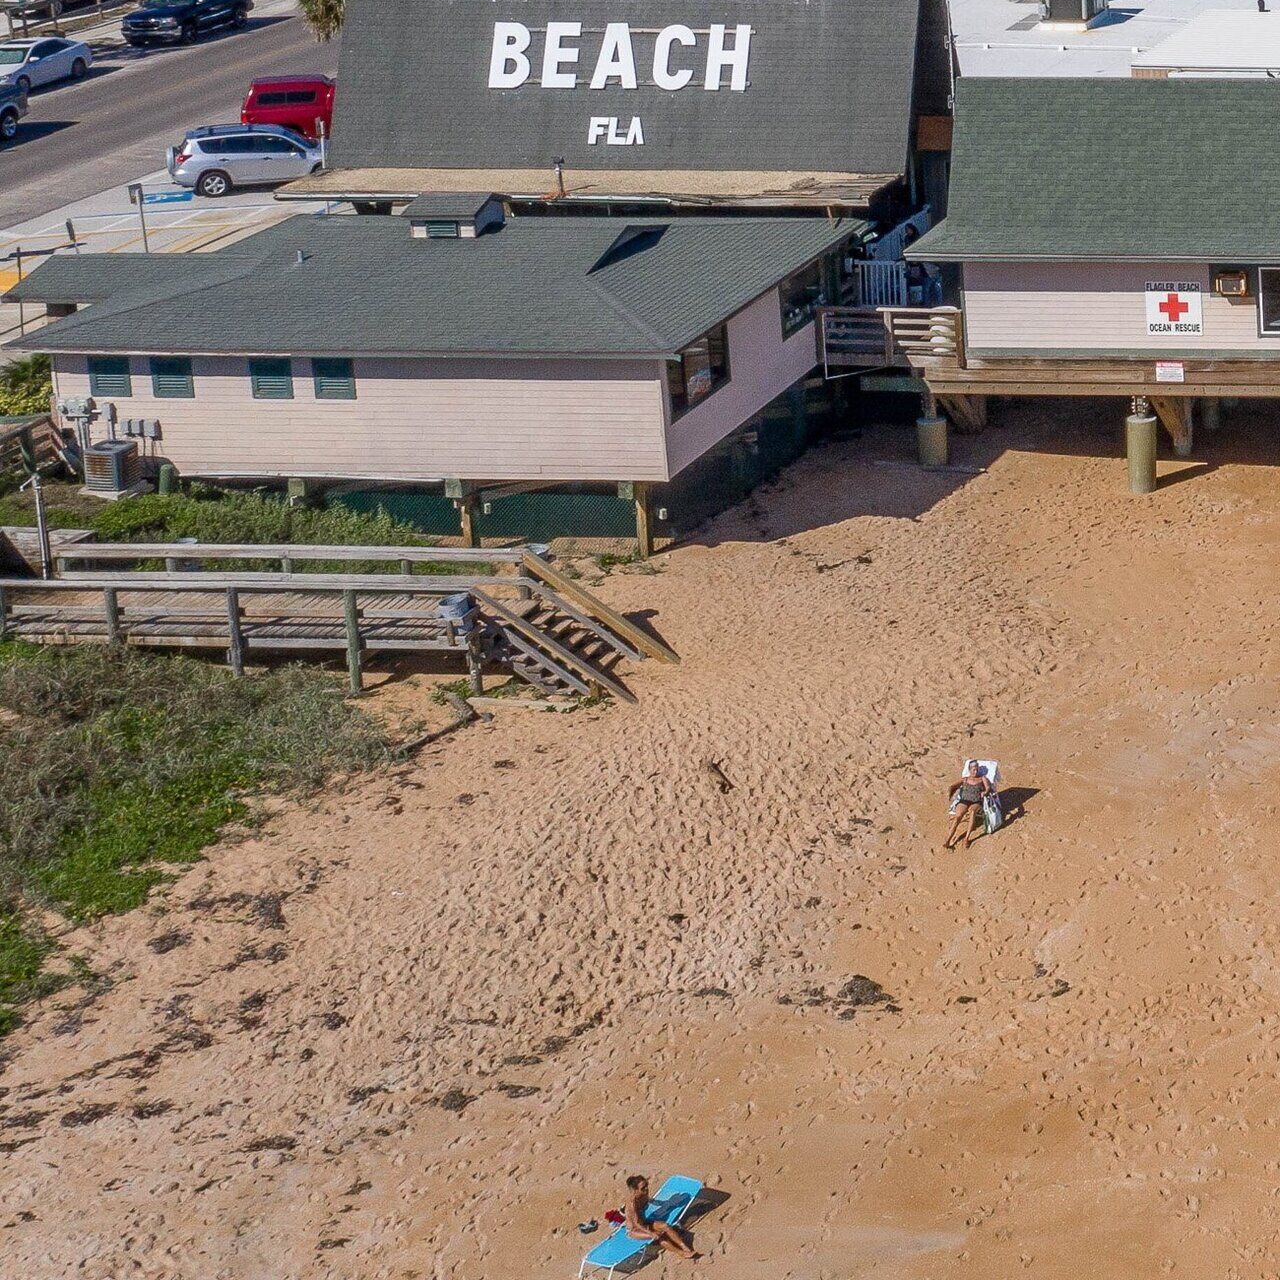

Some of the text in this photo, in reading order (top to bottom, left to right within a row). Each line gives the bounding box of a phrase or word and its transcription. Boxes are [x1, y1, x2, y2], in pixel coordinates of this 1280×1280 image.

[488, 22, 752, 92] BEACH
[588, 117, 644, 147] FLA
[1146, 282, 1200, 291] FLAGLER BEACH
[1149, 323, 1201, 332] OCEAN RESCUE
